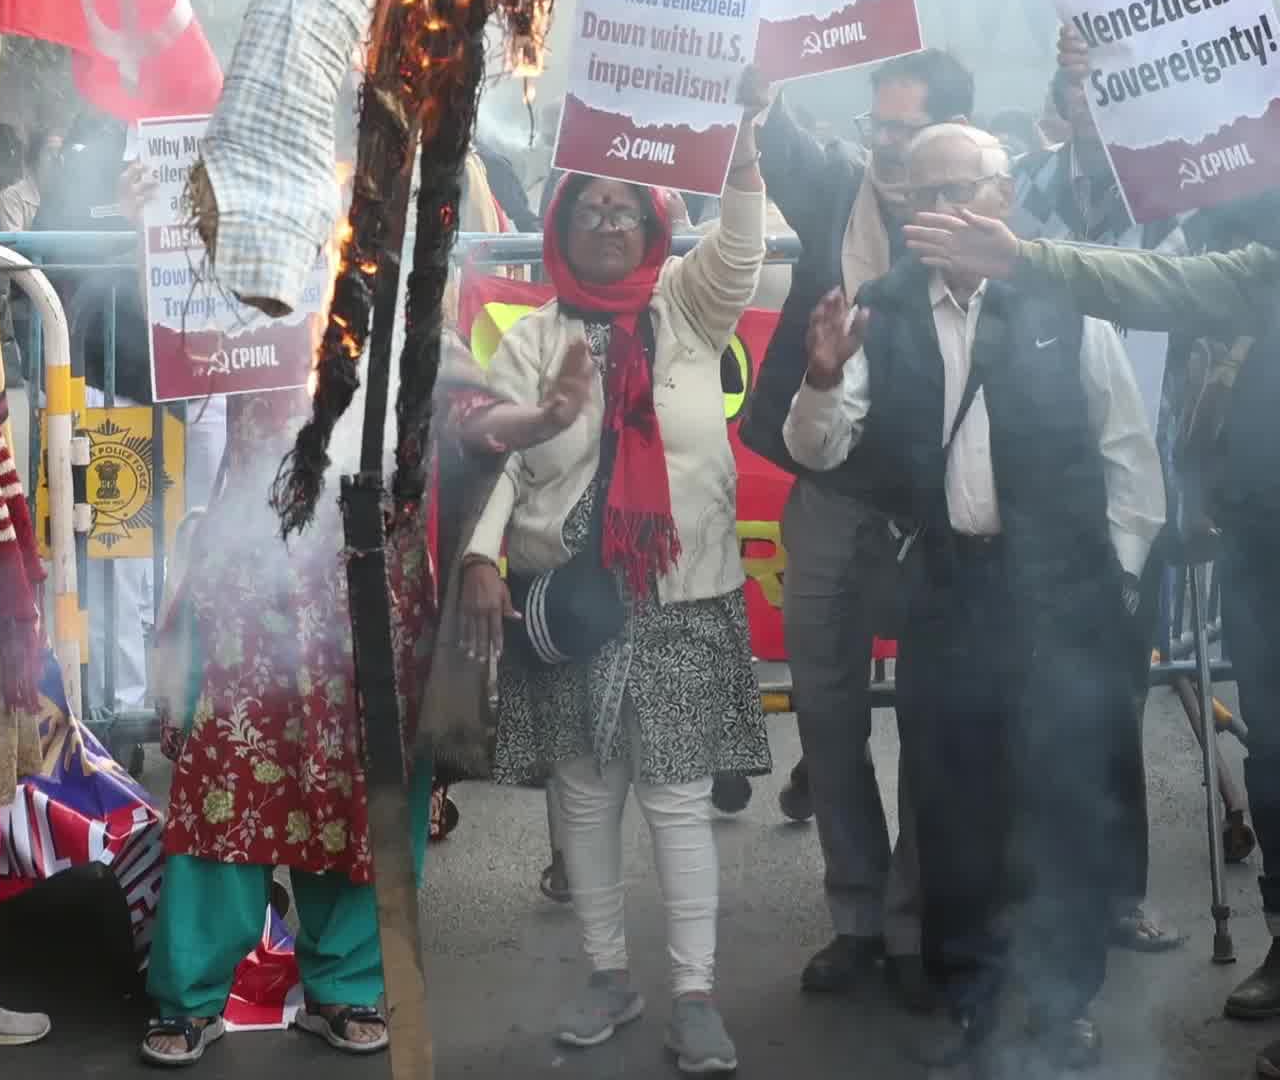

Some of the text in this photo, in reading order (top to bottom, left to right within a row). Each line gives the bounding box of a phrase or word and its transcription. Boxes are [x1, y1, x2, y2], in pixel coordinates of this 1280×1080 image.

[581, 11, 746, 64] Down with U.S.
[823, 21, 866, 49] CPIML
[1091, 13, 1278, 107] Sovereignty!
[587, 52, 731, 105] imperialism!
[149, 136, 179, 159] Why
[630, 137, 676, 166] CPIML
[1200, 143, 1256, 178] CPIML
[231, 344, 279, 369] CPIML
[97, 446, 131, 460] POLICE
